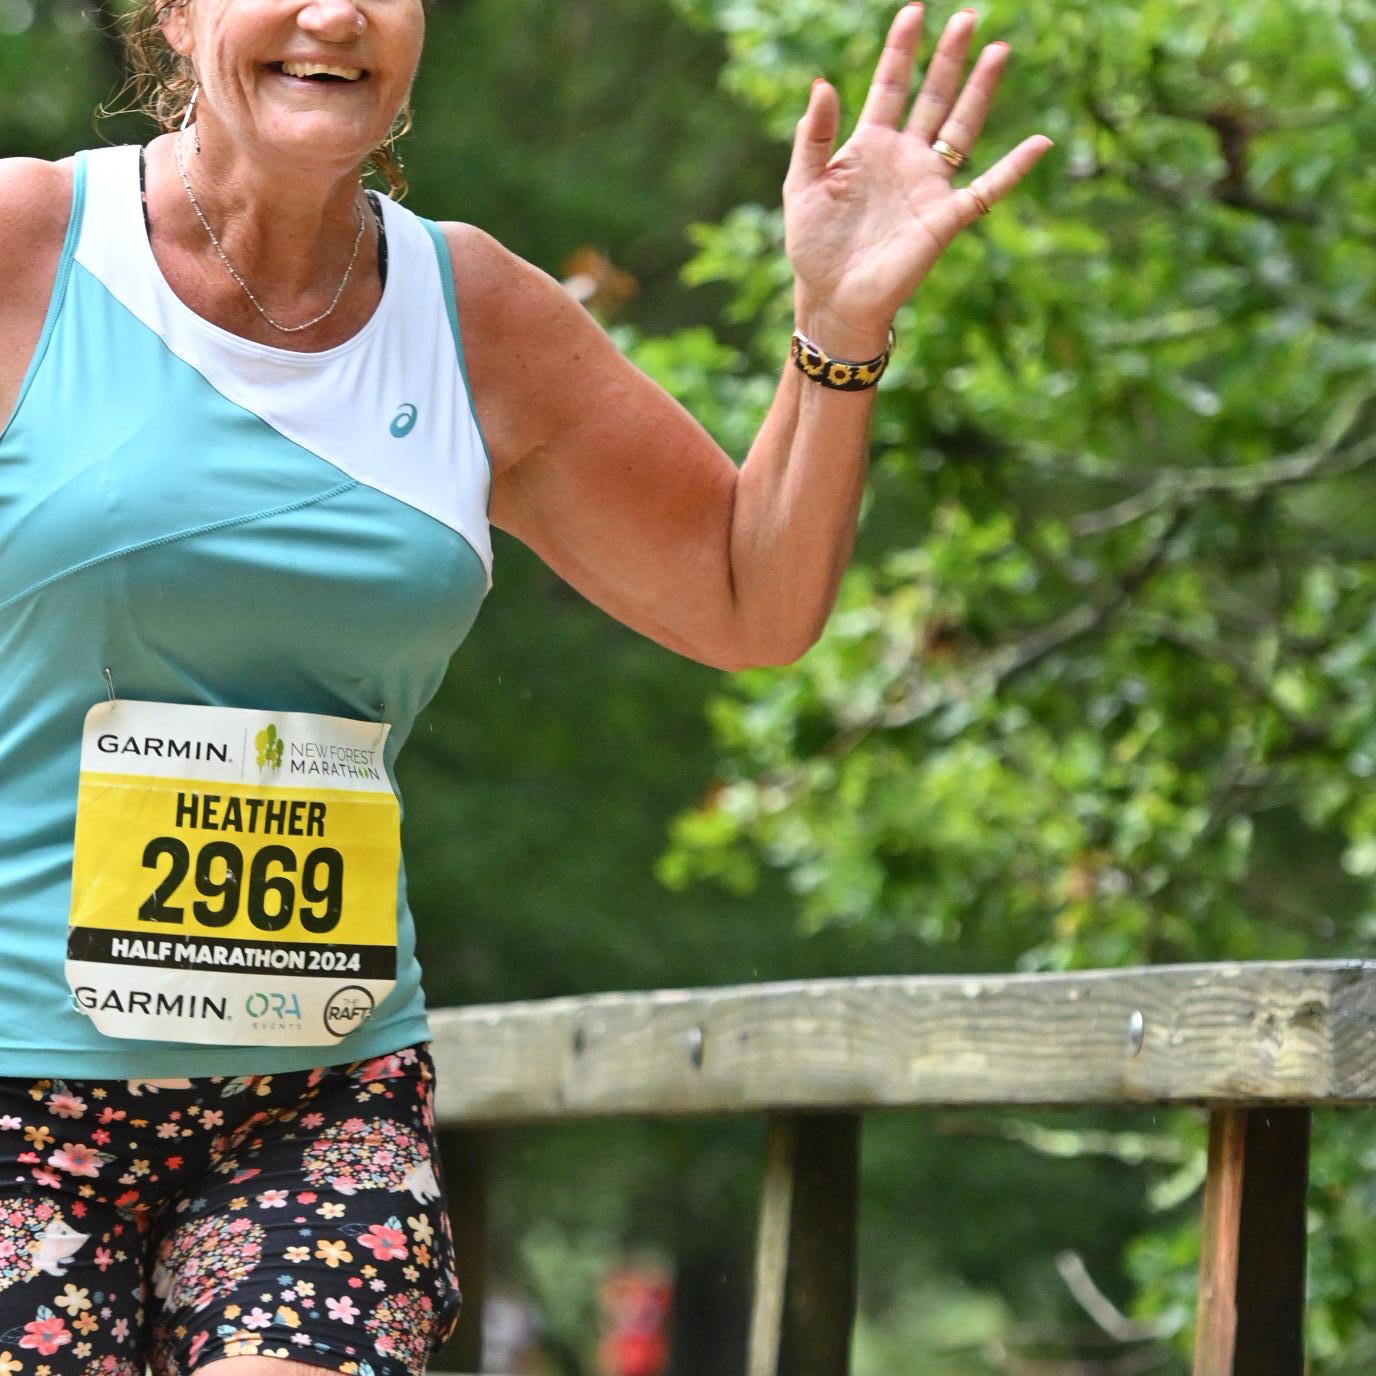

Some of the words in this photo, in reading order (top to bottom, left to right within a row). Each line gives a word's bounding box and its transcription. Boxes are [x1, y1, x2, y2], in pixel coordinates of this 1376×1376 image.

[291, 742, 328, 758] NEW
[329, 745, 376, 766] FOREST
[176, 792, 327, 837] HEATHER
[138, 836, 344, 934] 2969
[111, 937, 172, 961] HALF
[175, 942, 306, 970] MARATHON
[307, 950, 361, 972] 2024
[245, 992, 302, 1020] ORA
